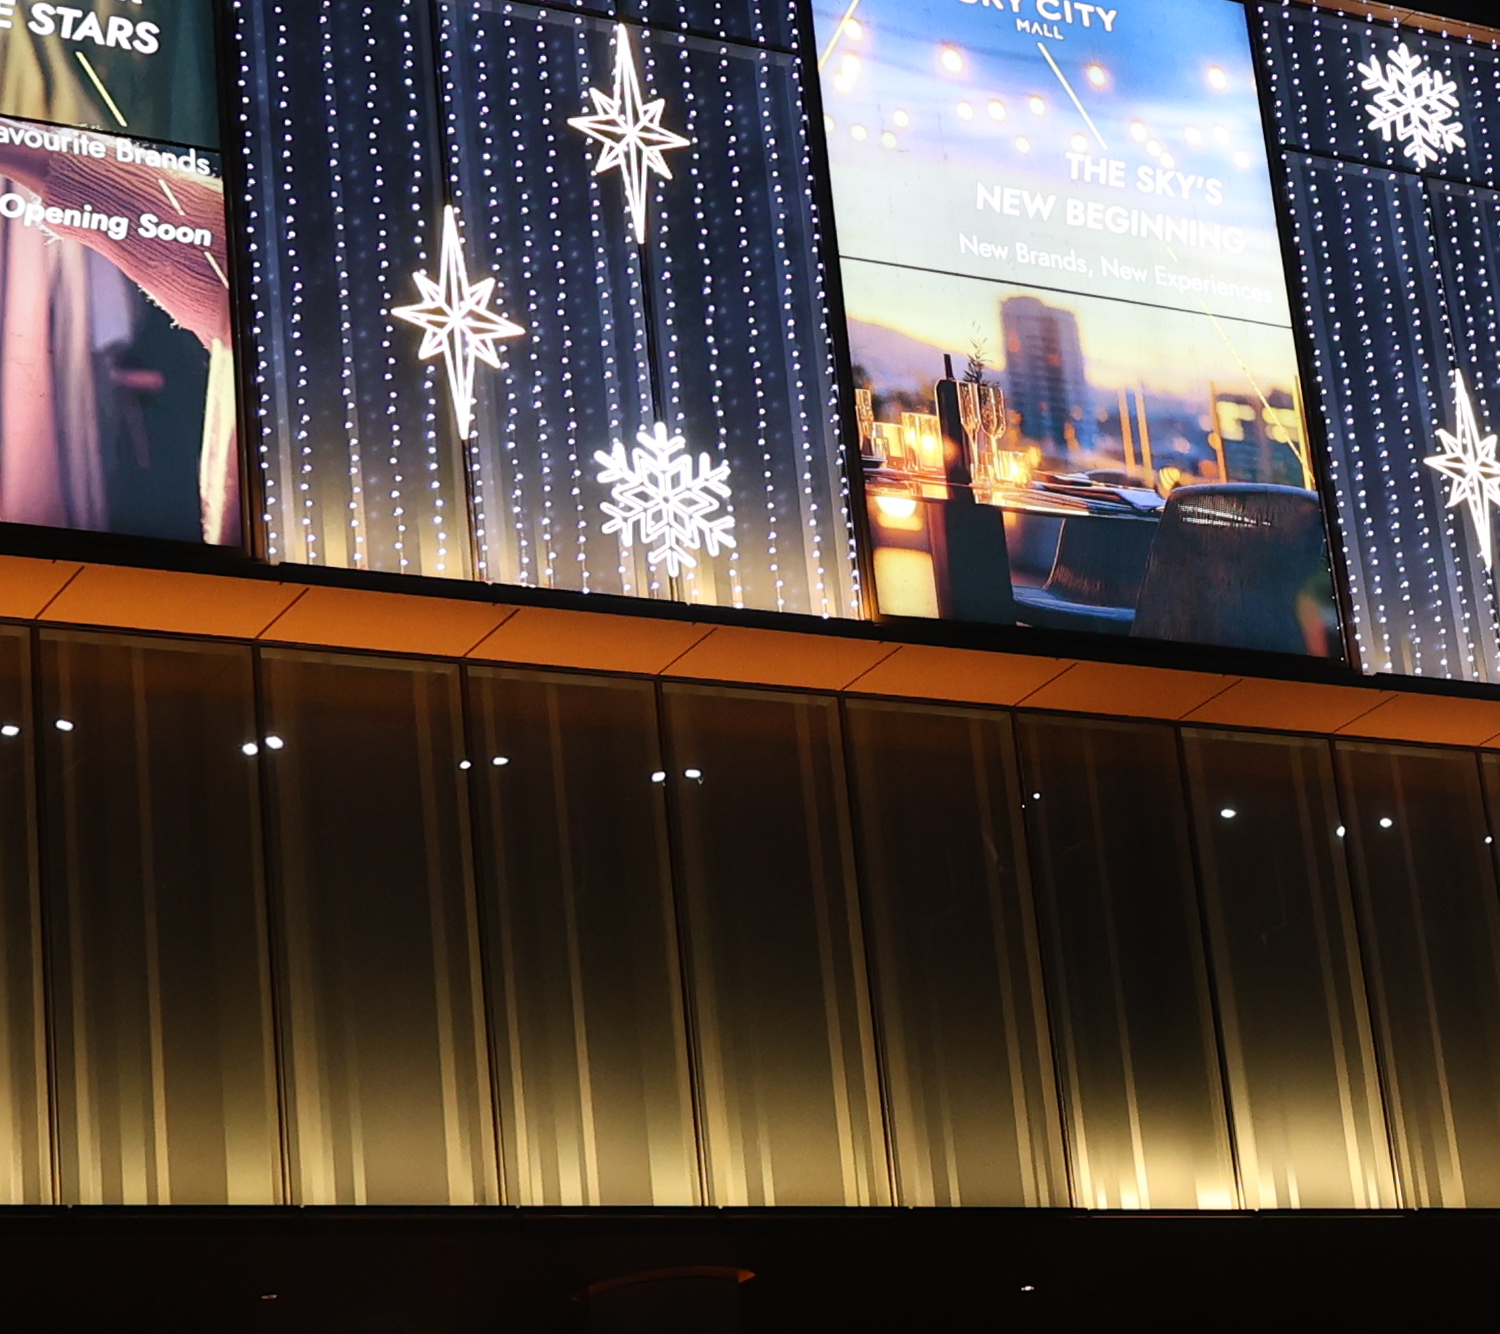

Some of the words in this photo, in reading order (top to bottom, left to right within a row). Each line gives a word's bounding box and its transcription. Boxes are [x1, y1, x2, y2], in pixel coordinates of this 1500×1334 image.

[27, 2, 160, 54] STARS
[1016, 18, 1064, 40] MALL
[1065, 152, 1126, 188] THE
[1136, 165, 1223, 205] SKY'S
[137, 213, 212, 247] Soon
[976, 182, 1057, 221] NEW
[1066, 198, 1246, 254] BEGINNING
[959, 232, 1008, 261] New
[1015, 242, 1094, 278] Brands,
[1101, 256, 1148, 283] New
[1155, 265, 1273, 304] Experiences
